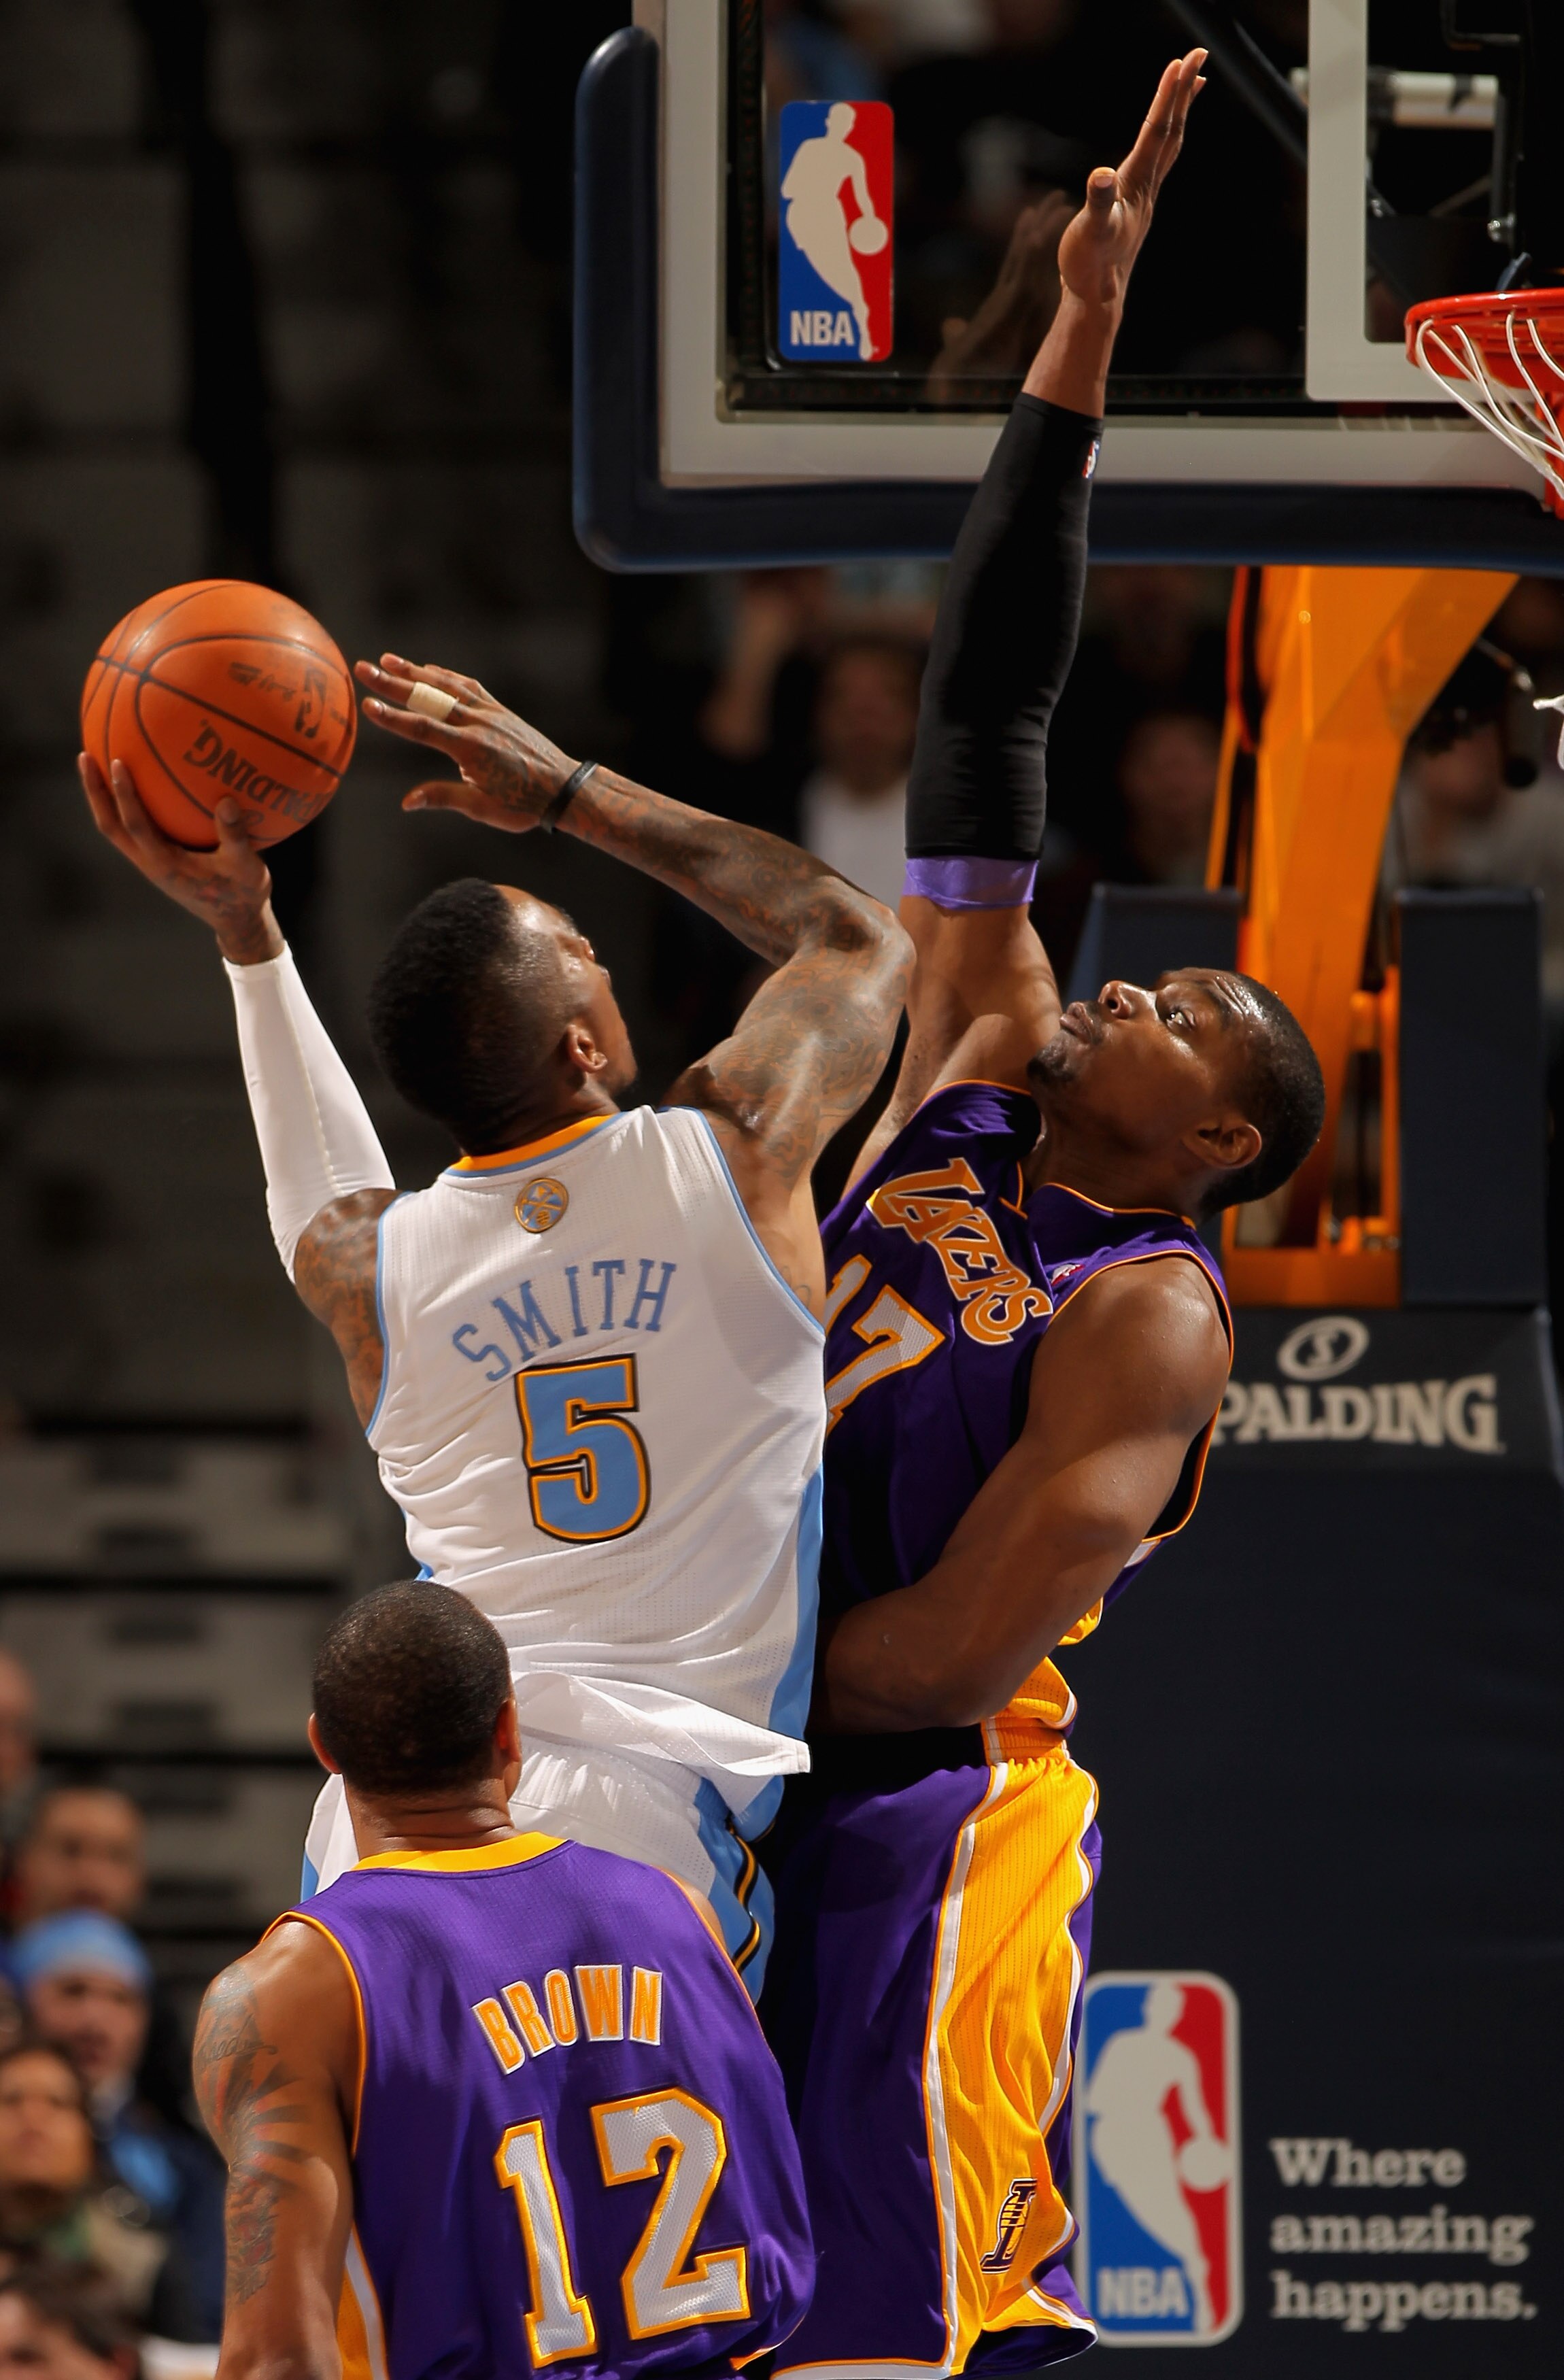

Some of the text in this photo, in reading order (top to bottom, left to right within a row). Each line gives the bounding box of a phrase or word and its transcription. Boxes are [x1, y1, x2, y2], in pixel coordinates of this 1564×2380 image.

[790, 310, 855, 346] NBA
[183, 726, 335, 824] PALDING
[866, 1157, 1053, 1346] LAKERS
[452, 1258, 676, 1381] SMITH
[515, 1353, 651, 1544] 5
[1213, 1373, 1500, 1455] PALDING
[471, 1964, 663, 2075] BROWN
[1268, 2137, 1467, 2188] Where
[494, 2086, 751, 2369] 12
[1270, 2203, 1536, 2267] amazing
[1098, 2266, 1189, 2319] NBA
[1270, 2268, 1538, 2333] happens.
